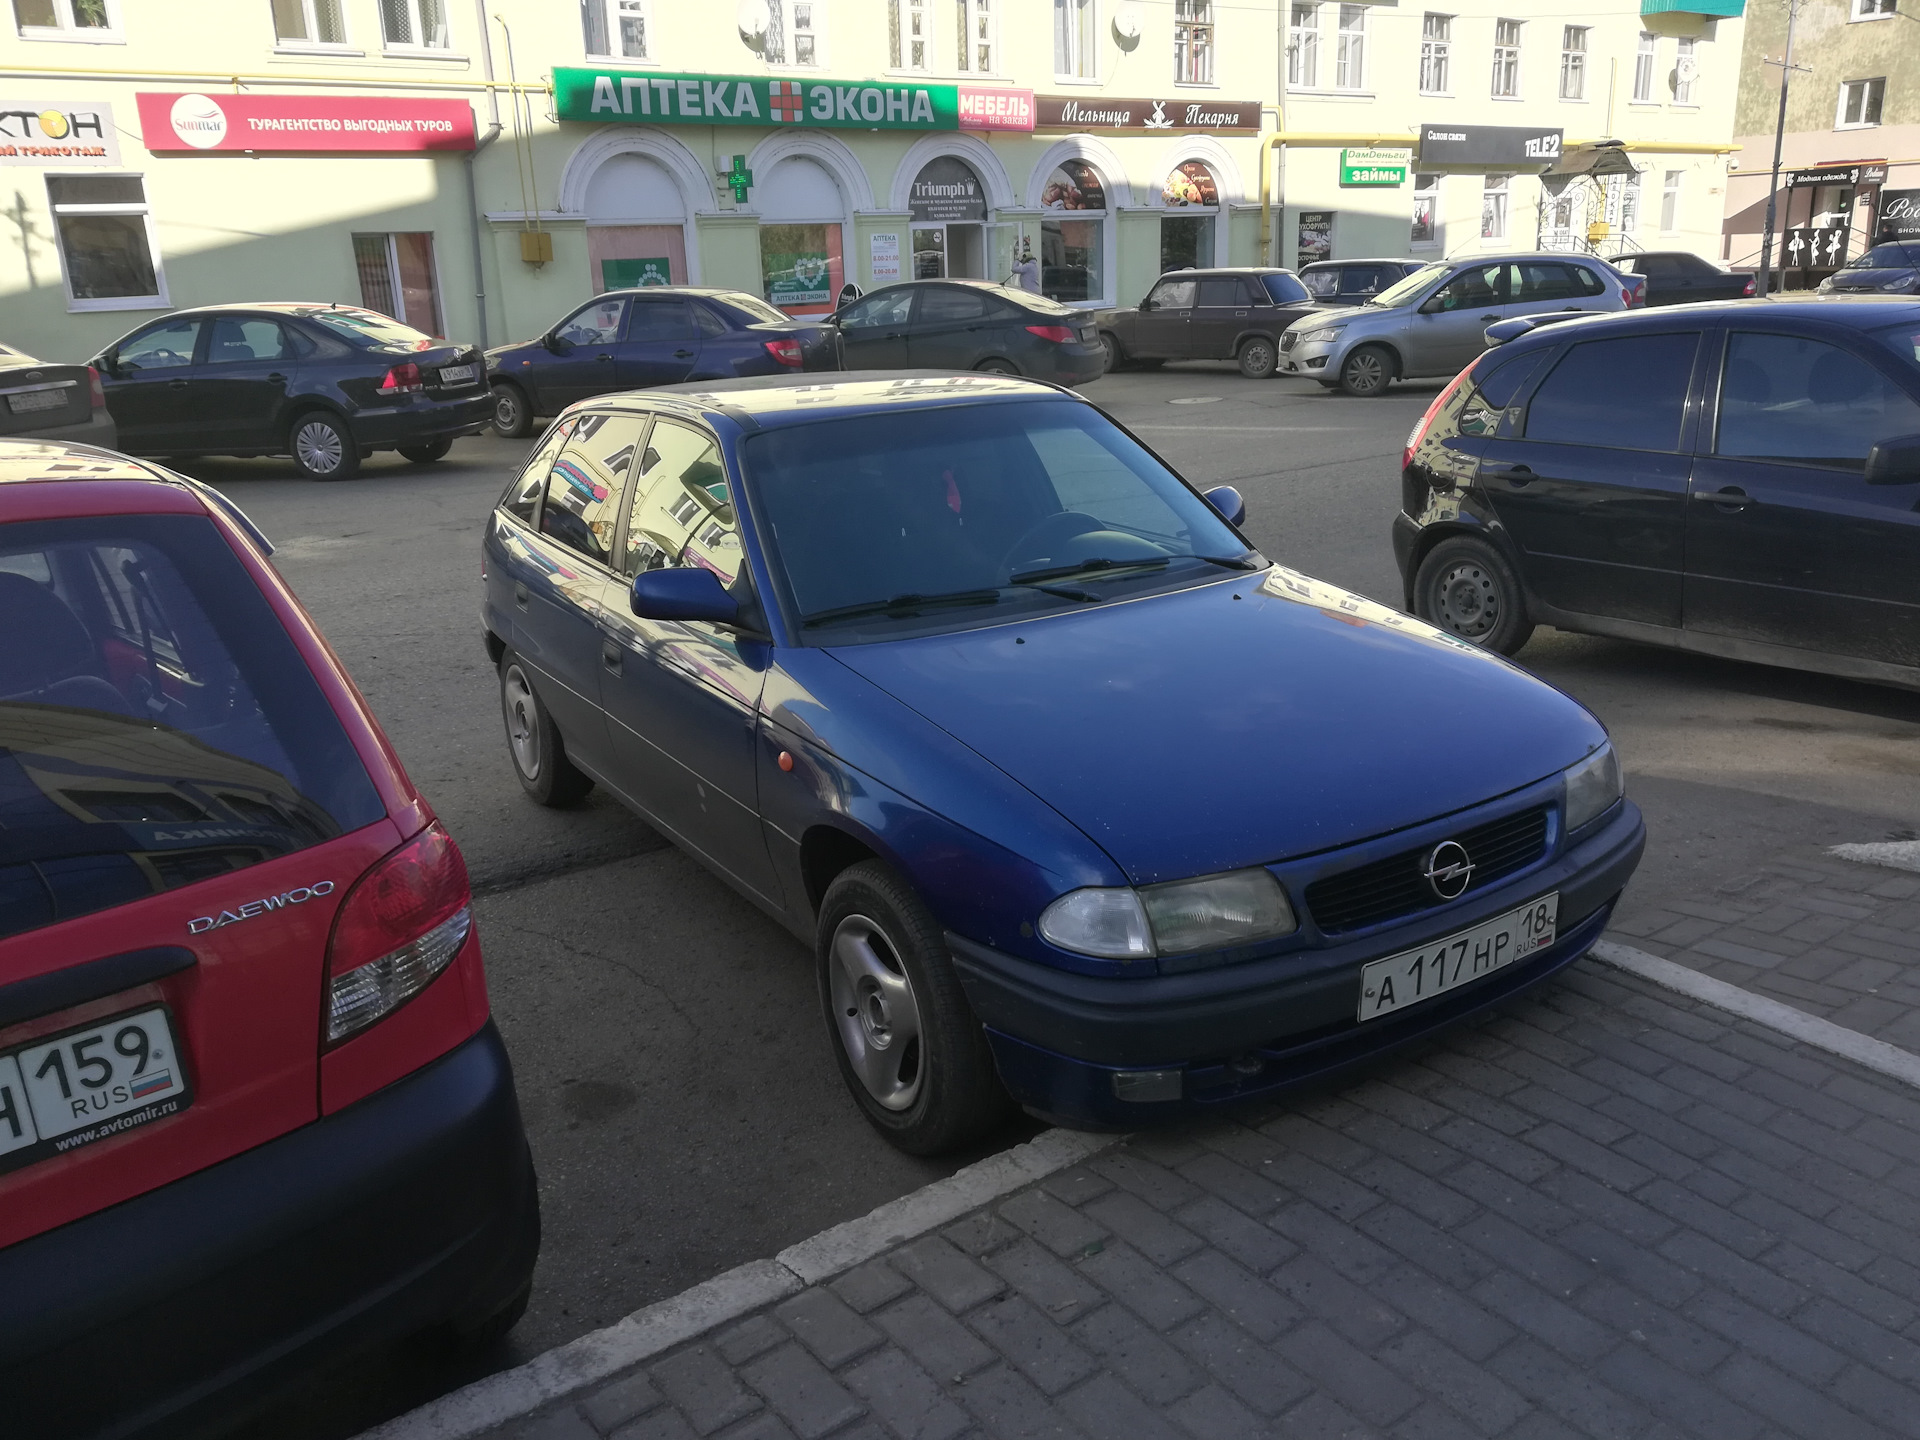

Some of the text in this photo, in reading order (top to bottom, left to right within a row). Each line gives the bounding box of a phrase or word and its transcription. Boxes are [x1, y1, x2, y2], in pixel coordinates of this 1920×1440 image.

[590, 76, 935, 123] АПТЕКА ЭКОНА
[960, 94, 1029, 116] МЕБЕЛЬ
[989, 116, 1000, 124] на
[1002, 117, 1028, 125] заказ
[1061, 100, 1240, 129] Мельница Пекарня
[174, 118, 224, 132] Sunmar
[247, 117, 453, 133] ТУРАГЕНТСТВО ВЫГОДНЫХ ТУРОВ
[1427, 130, 1466, 141] Салон связи
[18, 146, 106, 157] ТРИКОТАЖ
[1525, 134, 1560, 158] TELE2
[1351, 167, 1401, 182] займы
[1796, 173, 1847, 183] Модная одежда
[914, 181, 965, 198] Triumph
[1299, 222, 1331, 230] УХОФРУКТЫ
[776, 294, 801, 302] АПТЕКА
[187, 880, 335, 935] DAEWOO
[1521, 902, 1548, 939] 18
[1516, 937, 1537, 956] RUS
[34, 1025, 149, 1099] 159
[70, 1085, 129, 1119] RUS
[55, 1100, 178, 1152] www.avtomir.ru
